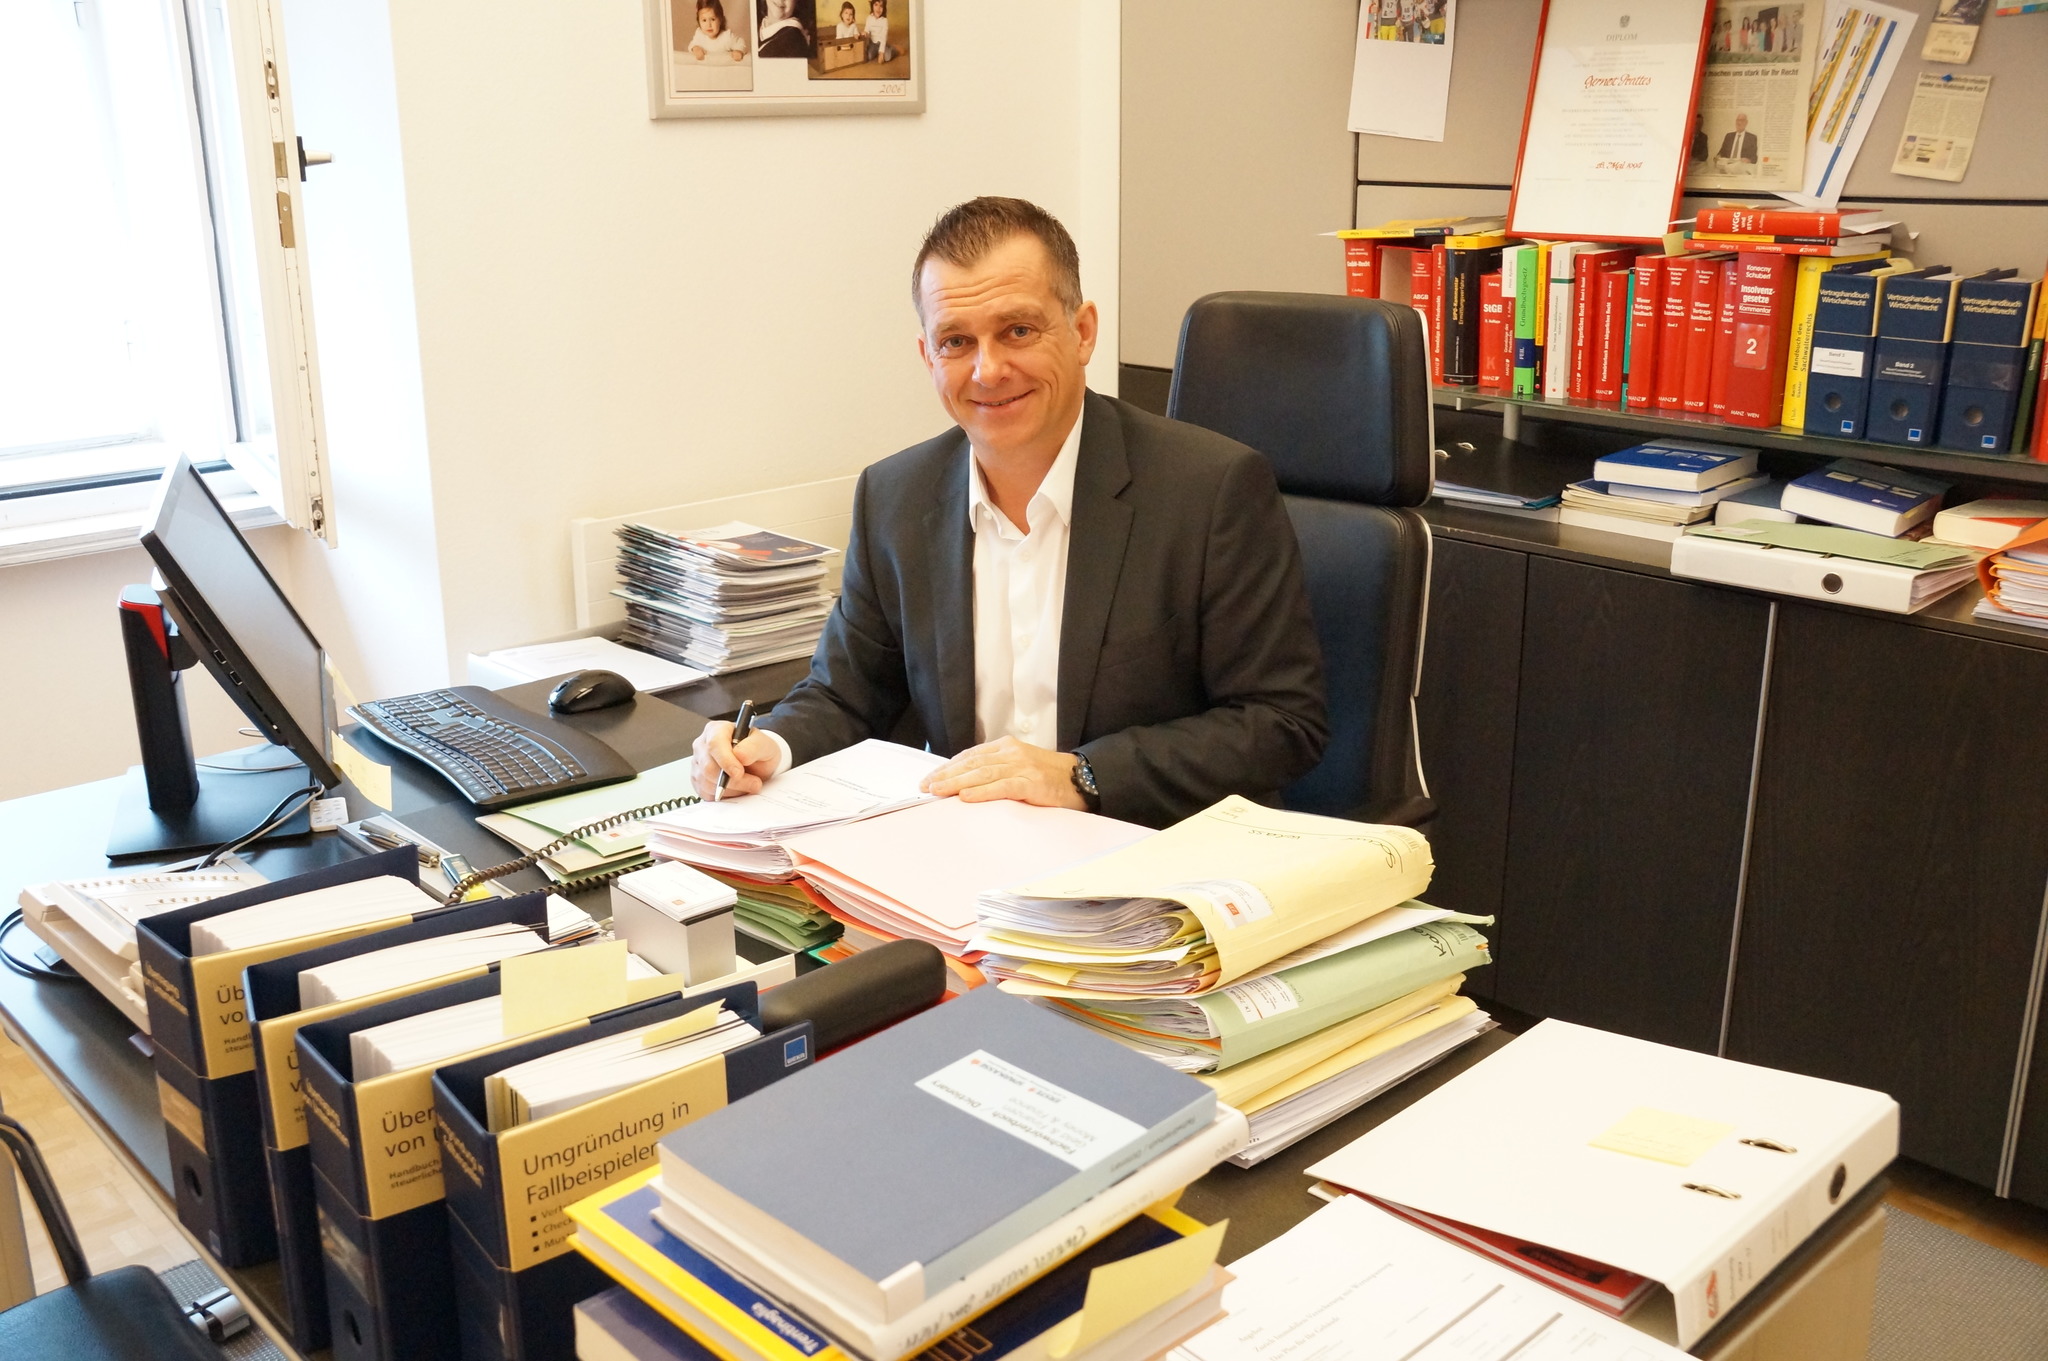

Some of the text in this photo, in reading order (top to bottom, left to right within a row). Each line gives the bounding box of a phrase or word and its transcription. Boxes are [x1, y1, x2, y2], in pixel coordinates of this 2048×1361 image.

[1605, 33, 1638, 42] DIPLOM
[1780, 68, 1798, 76] Recht
[1731, 211, 1741, 232] WGG
[1745, 271, 1771, 280] Schubert
[1740, 284, 1776, 296] Insolvenz-
[1519, 266, 1529, 327] Grundbuchsgesetz
[1742, 294, 1770, 305] gesetze
[1821, 296, 1867, 307] Wirtschaftsrecht
[1483, 303, 1503, 313] StGB
[1738, 304, 1772, 314] Kommentar
[1888, 301, 1939, 312] Wirtschaftsrecht
[1962, 305, 2018, 316] Wirtschaftsrecht
[1746, 338, 1757, 355] 2
[1792, 322, 1803, 371] Handbuch des
[1800, 313, 1813, 372] Sachwalterrechts
[1895, 361, 1910, 369] Band
[1730, 409, 1760, 419] MANZ WIEN
[220, 1011, 244, 1025] vo
[931, 1078, 982, 1109] Dictionary
[523, 1111, 664, 1176] Umgründung
[672, 1100, 689, 1121] in
[991, 1111, 1077, 1155] Fachwörterbuch
[384, 1135, 425, 1158] von
